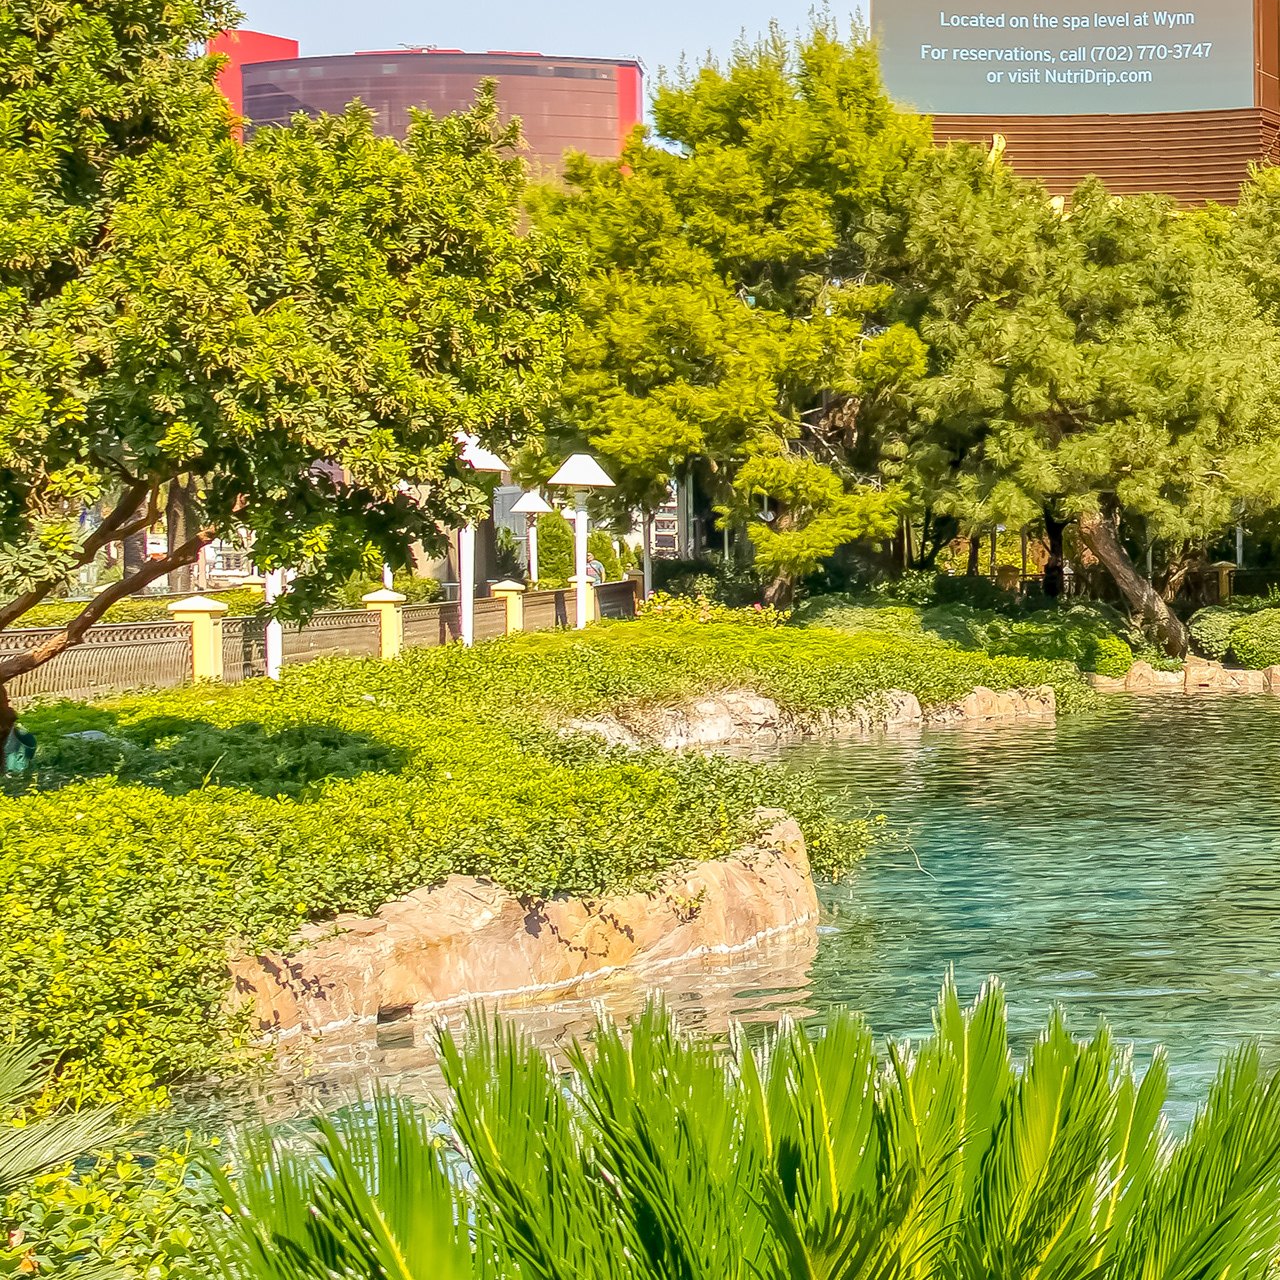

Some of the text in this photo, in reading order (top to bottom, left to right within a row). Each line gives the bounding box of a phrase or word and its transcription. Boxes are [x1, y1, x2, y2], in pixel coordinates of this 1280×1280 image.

[940, 10, 1195, 31] Located on the spa level at Wynn
[920, 42, 1213, 64] For reservations, call (702) 770-3747
[986, 68, 1153, 87] or visit NutriDrip.com
